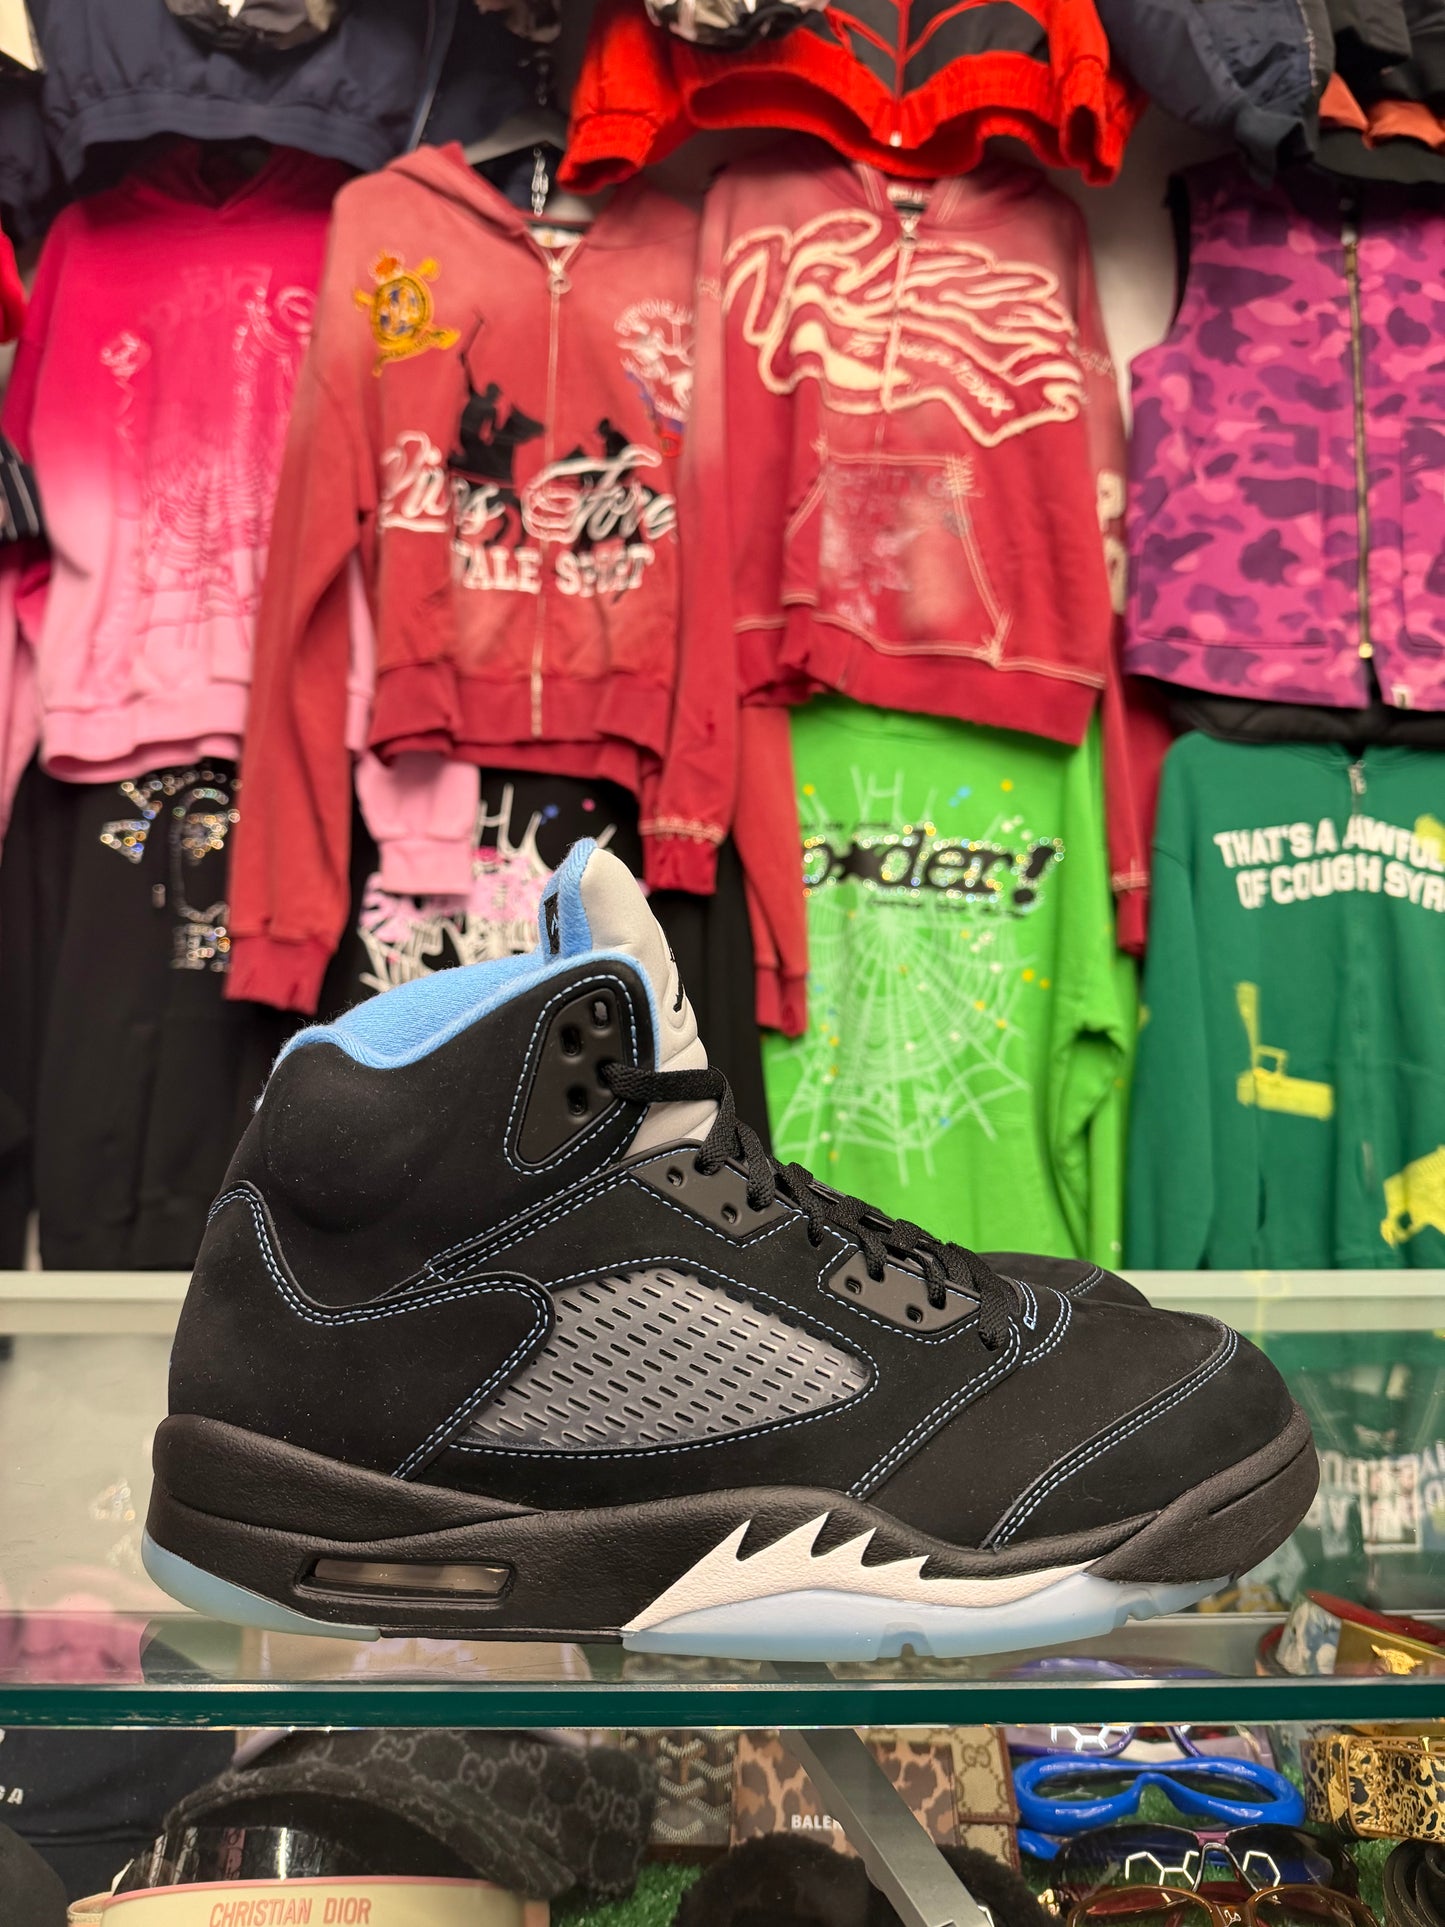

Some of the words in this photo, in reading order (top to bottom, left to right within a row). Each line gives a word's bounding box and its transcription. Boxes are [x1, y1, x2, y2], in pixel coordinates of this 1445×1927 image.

[1213, 822, 1314, 868] THAT'S
[1315, 817, 1339, 854] A
[1236, 868, 1269, 909] OF
[1270, 853, 1382, 904] COUGH
[210, 1898, 312, 1927] CHRISTIAN
[323, 1897, 372, 1925] DIOR
